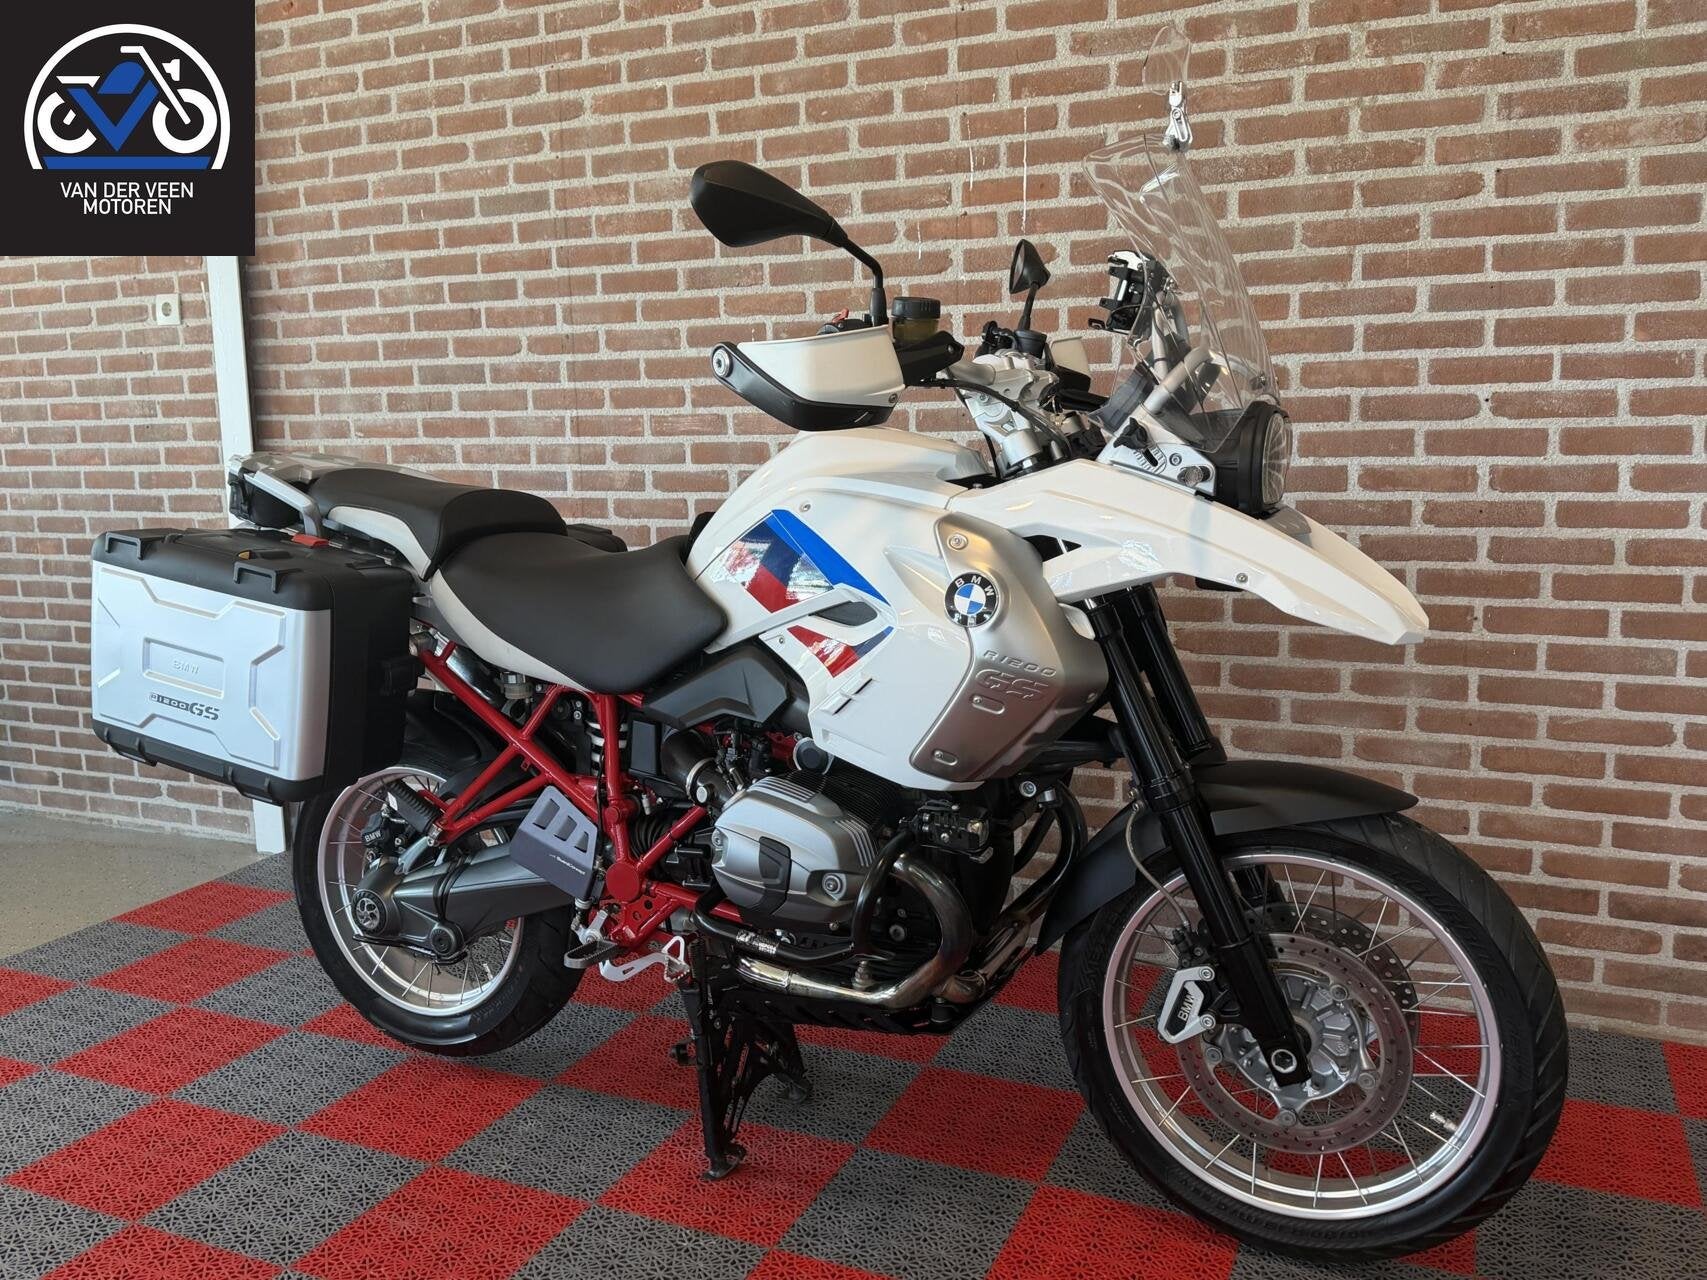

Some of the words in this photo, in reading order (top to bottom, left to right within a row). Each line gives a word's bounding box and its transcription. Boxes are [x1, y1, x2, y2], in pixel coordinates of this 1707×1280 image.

[954, 575, 995, 597] BMW
[975, 668, 1049, 700] GS
[364, 830, 382, 843] BMW
[1177, 992, 1195, 1022] BMW
